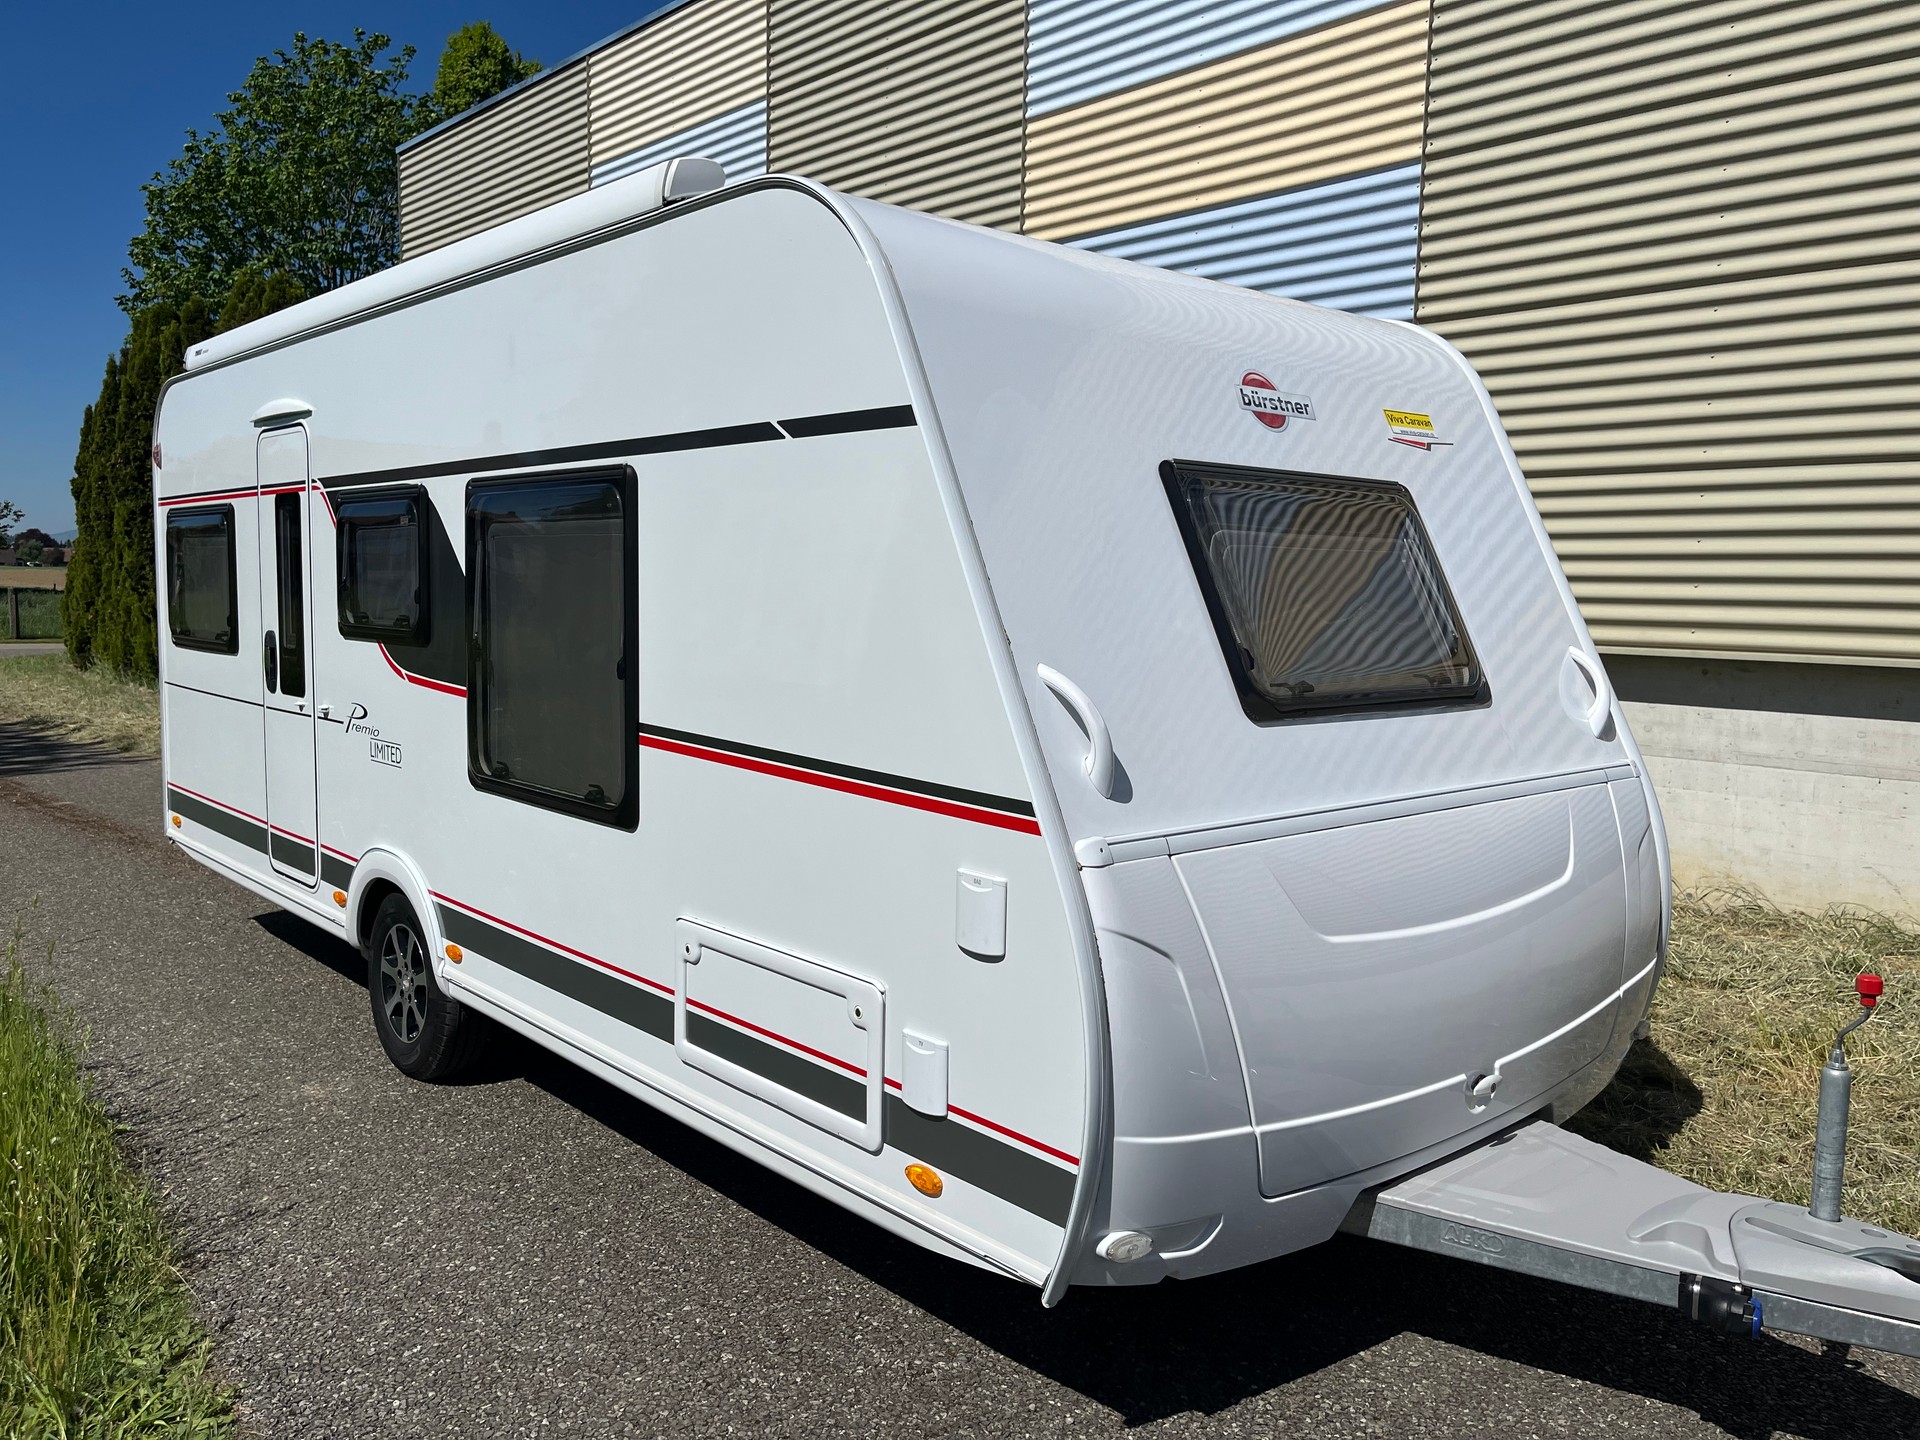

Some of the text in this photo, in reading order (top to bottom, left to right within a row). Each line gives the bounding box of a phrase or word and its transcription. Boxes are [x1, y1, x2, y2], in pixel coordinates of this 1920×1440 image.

[1240, 388, 1309, 415] bürstner
[1387, 413, 1433, 428] Viva Caravan
[345, 702, 380, 737] Premio
[370, 741, 402, 764] LIMITED
